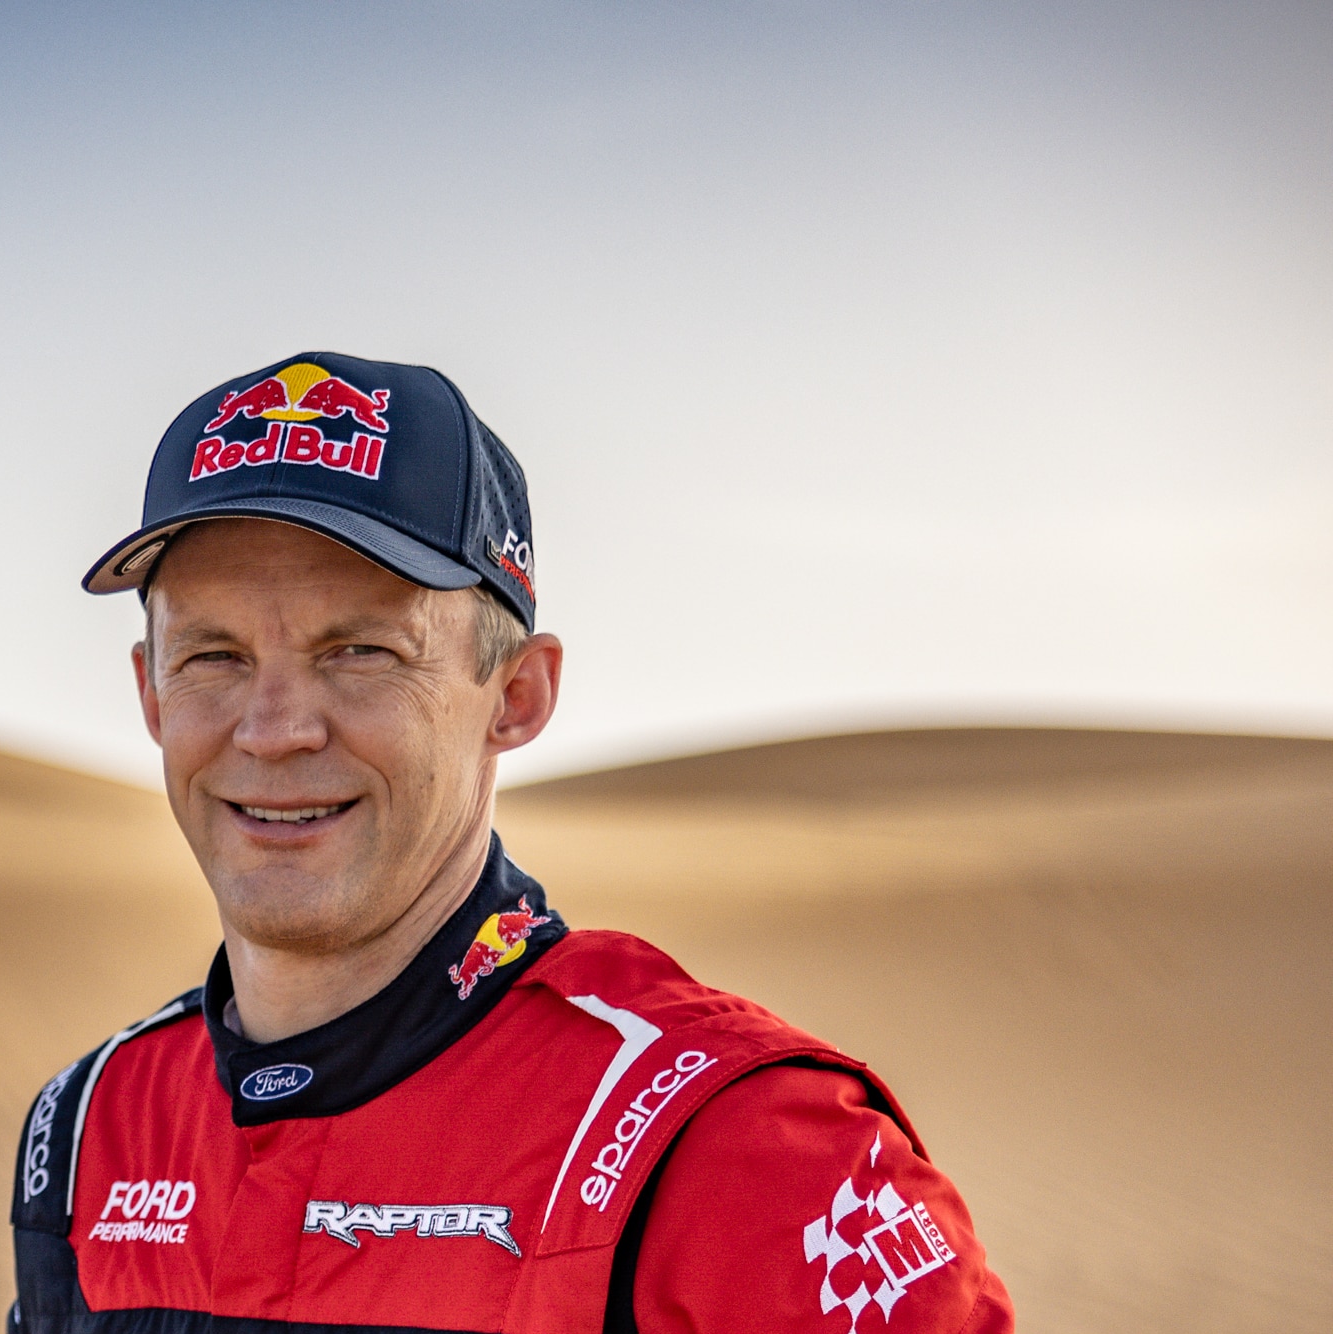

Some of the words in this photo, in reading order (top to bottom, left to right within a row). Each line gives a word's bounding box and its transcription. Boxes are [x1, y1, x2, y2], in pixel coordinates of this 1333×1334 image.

[190, 424, 281, 481] Red
[283, 426, 385, 479] Bull
[255, 1068, 299, 1097] Ford
[580, 1050, 718, 1211] sparco
[100, 1179, 197, 1220] FORD
[302, 1200, 522, 1259] RAPTOR
[871, 1216, 937, 1281] M
[916, 1205, 951, 1257] SPORT
